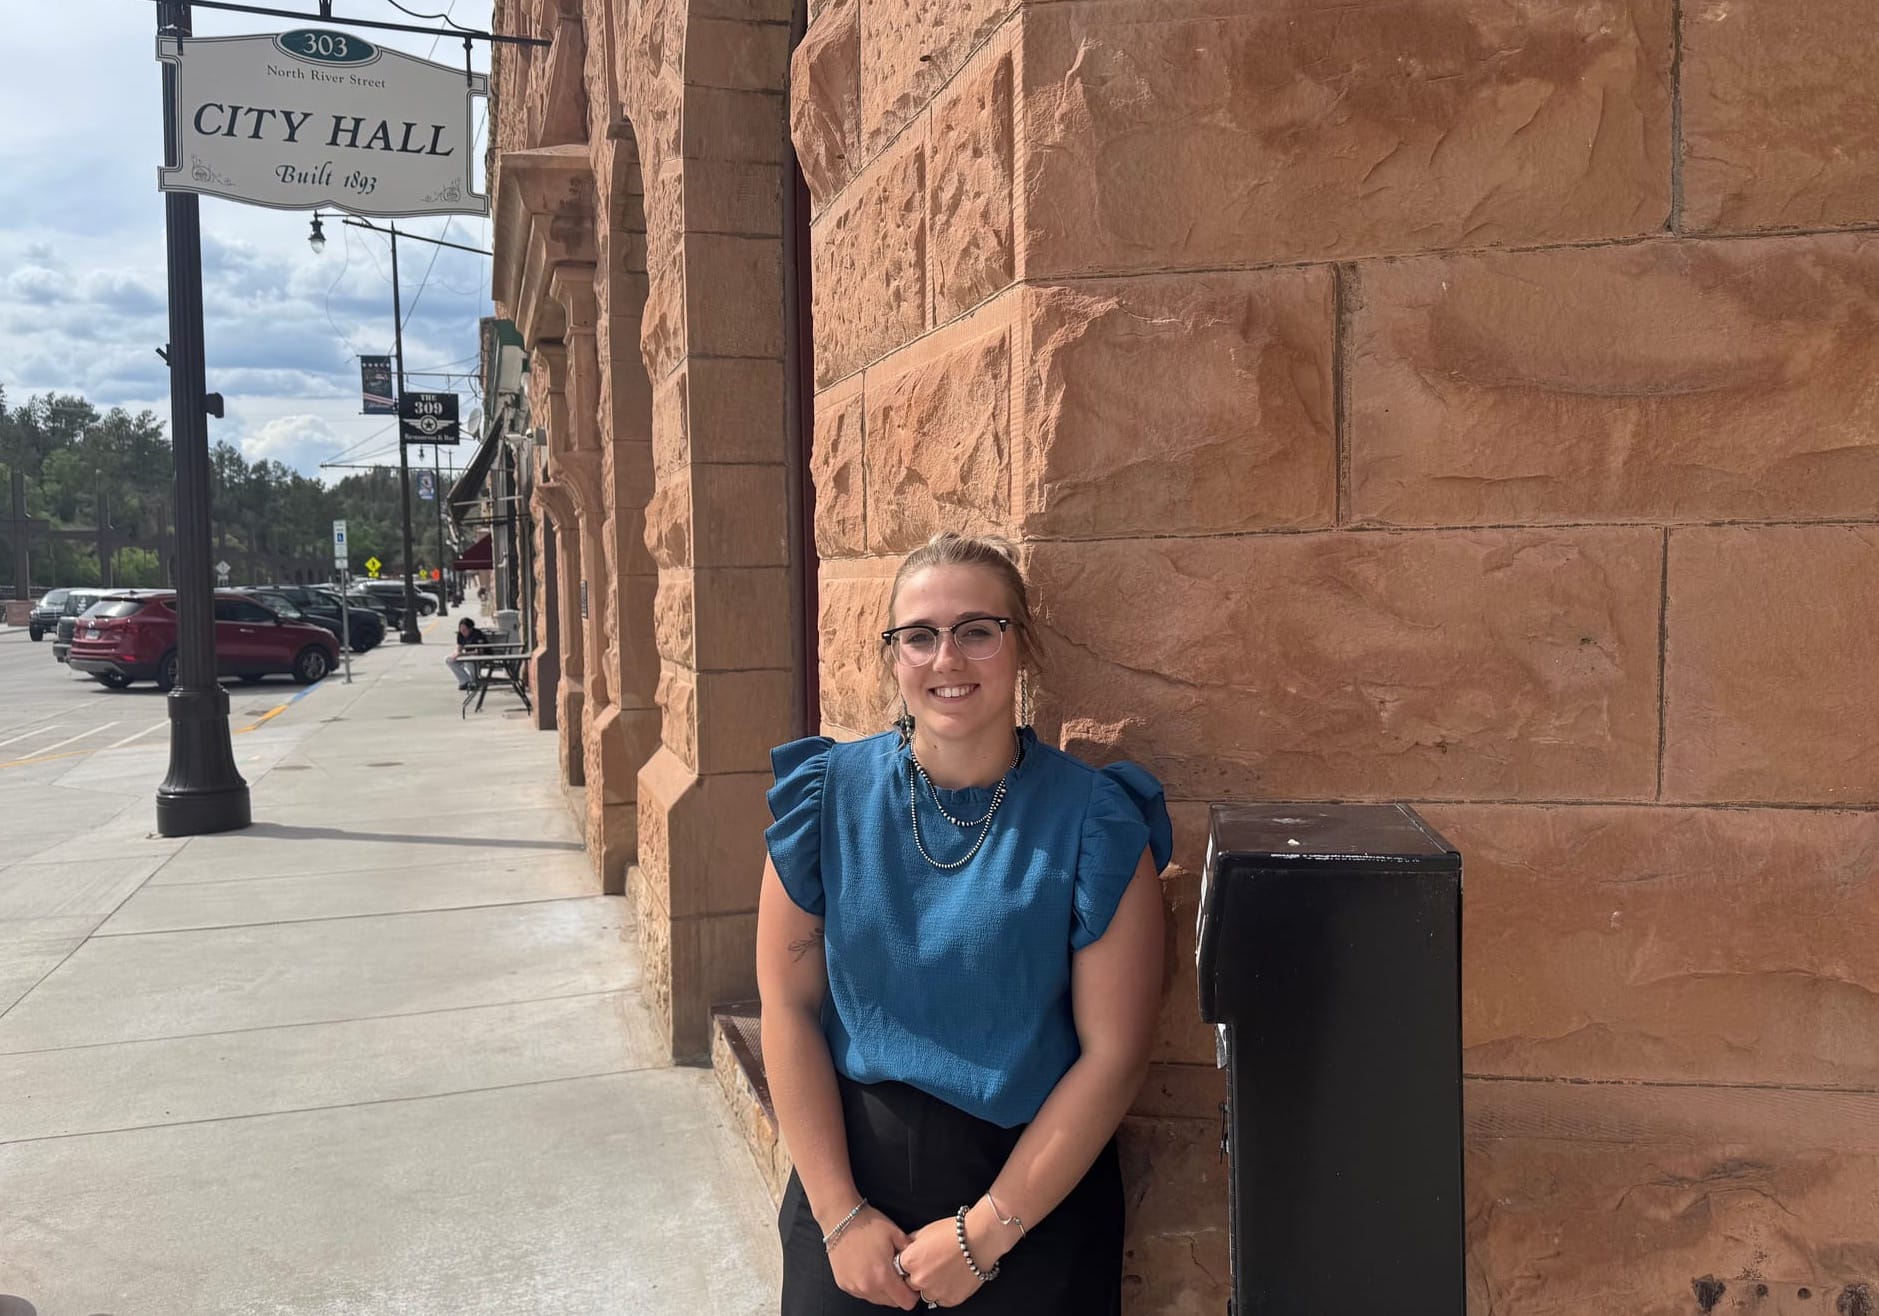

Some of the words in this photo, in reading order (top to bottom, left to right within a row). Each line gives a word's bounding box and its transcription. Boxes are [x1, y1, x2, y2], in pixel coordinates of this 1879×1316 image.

[303, 33, 348, 58] 303
[266, 64, 305, 80] North
[311, 70, 344, 84] River
[349, 74, 386, 89] Street
[194, 103, 312, 142] CITY
[326, 115, 454, 157] HALL
[275, 161, 333, 188] Built
[343, 171, 377, 195] 1893
[415, 402, 443, 415] 309
